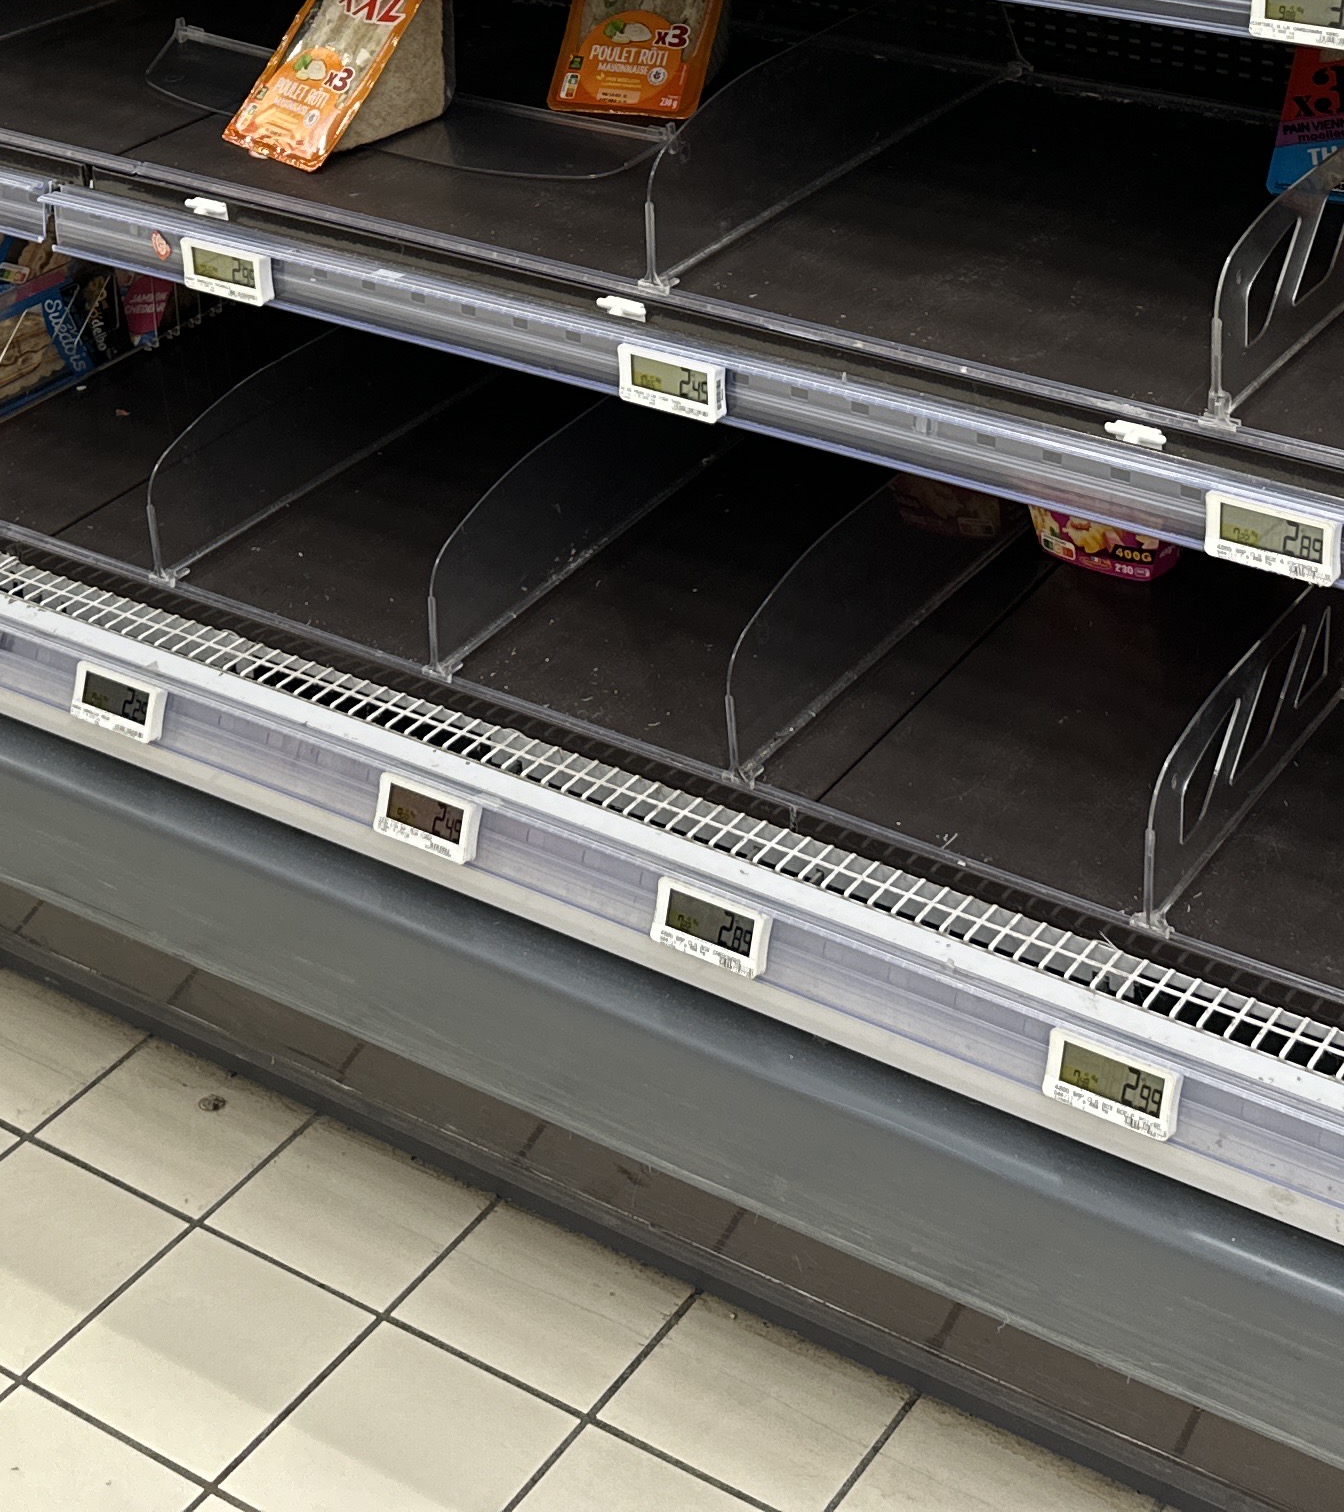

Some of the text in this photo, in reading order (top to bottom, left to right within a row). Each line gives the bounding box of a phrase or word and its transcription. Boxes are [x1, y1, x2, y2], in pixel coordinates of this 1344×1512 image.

[588, 43, 669, 68] POULET RÔTI
[1282, 120, 1311, 136] PAIN
[1115, 547, 1152, 564] 400G
